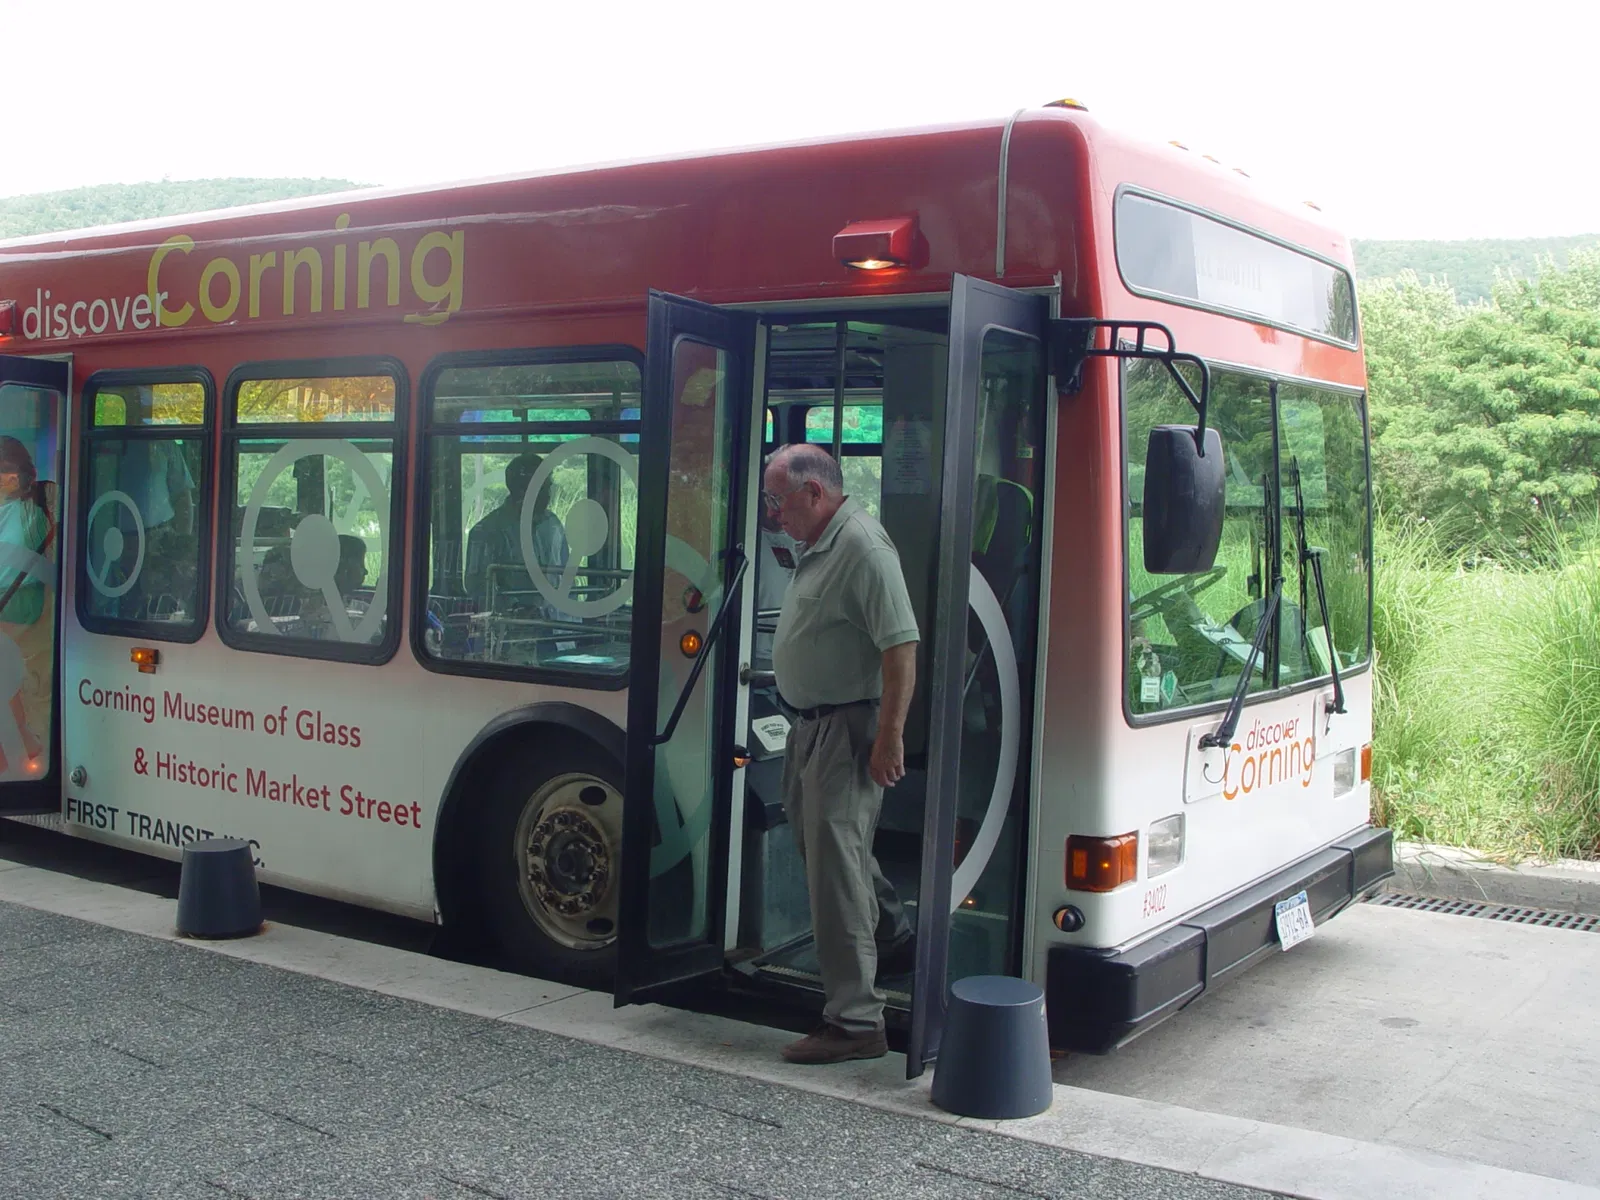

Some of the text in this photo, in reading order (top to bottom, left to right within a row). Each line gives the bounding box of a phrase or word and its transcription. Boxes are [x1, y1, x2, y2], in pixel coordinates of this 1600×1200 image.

[22, 213, 465, 340] discover Corning
[78, 678, 361, 748] Corning Museum of Glass
[1246, 718, 1299, 751] discover
[133, 746, 421, 829] & Historic Market Street
[1223, 737, 1312, 800] Corning
[66, 798, 119, 831] FIRST
